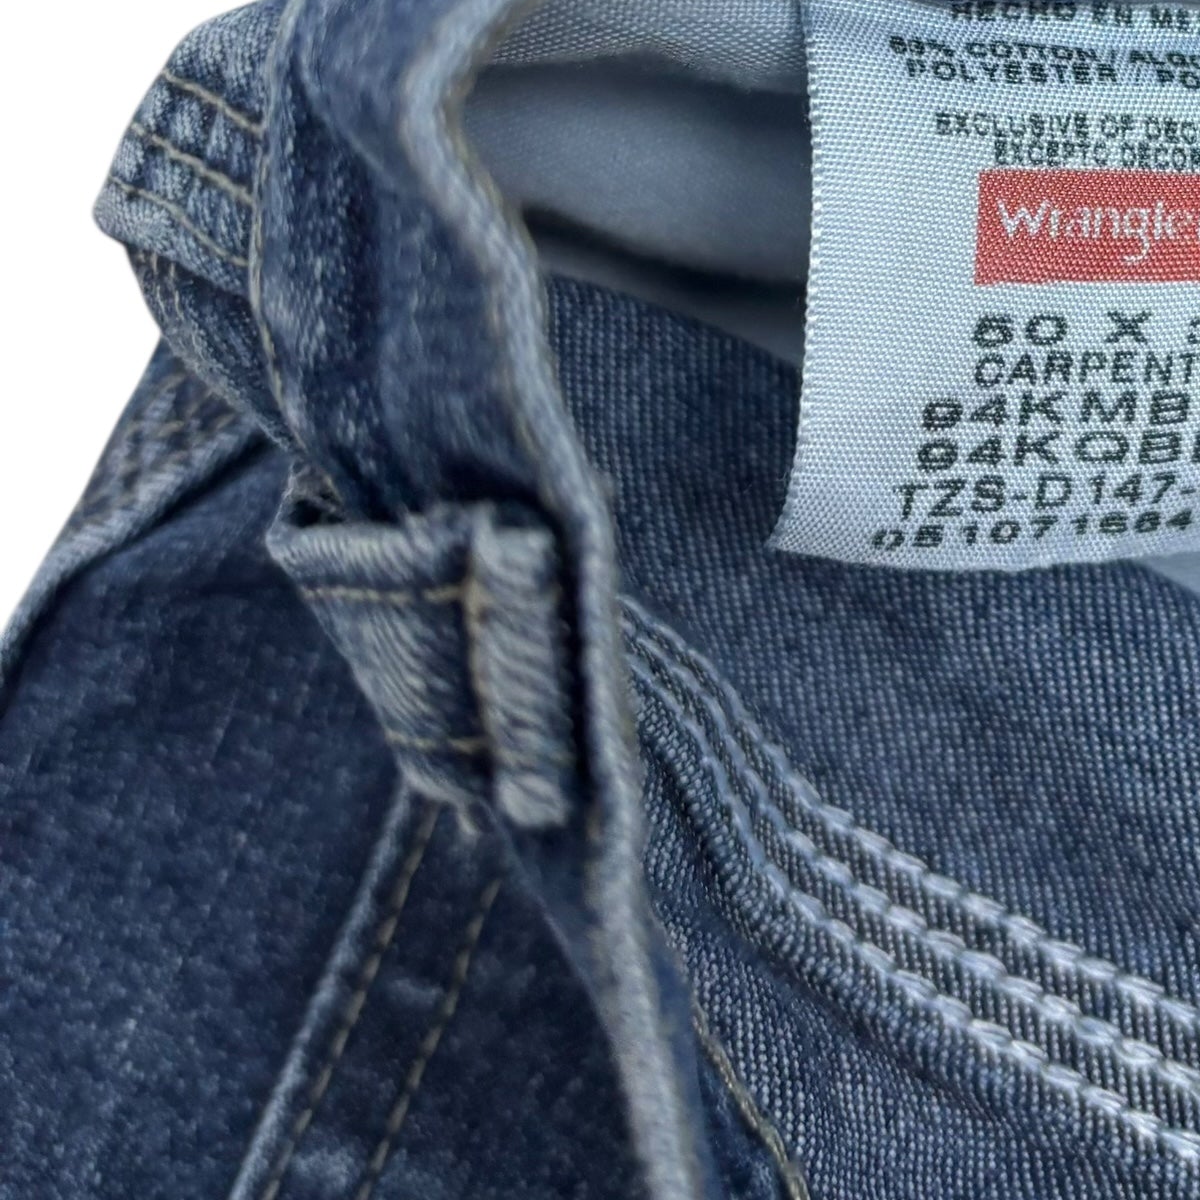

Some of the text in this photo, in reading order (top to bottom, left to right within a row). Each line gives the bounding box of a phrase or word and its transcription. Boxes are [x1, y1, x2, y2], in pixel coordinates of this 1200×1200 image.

[1091, 3, 1132, 27] EN
[964, 40, 1098, 63] COTTON
[905, 57, 1118, 86] POLYESTER
[934, 110, 1091, 139] EXCLUSIVE
[1101, 115, 1138, 139] OF
[993, 140, 1108, 168] EXCEPTO
[1105, 309, 1153, 345] X
